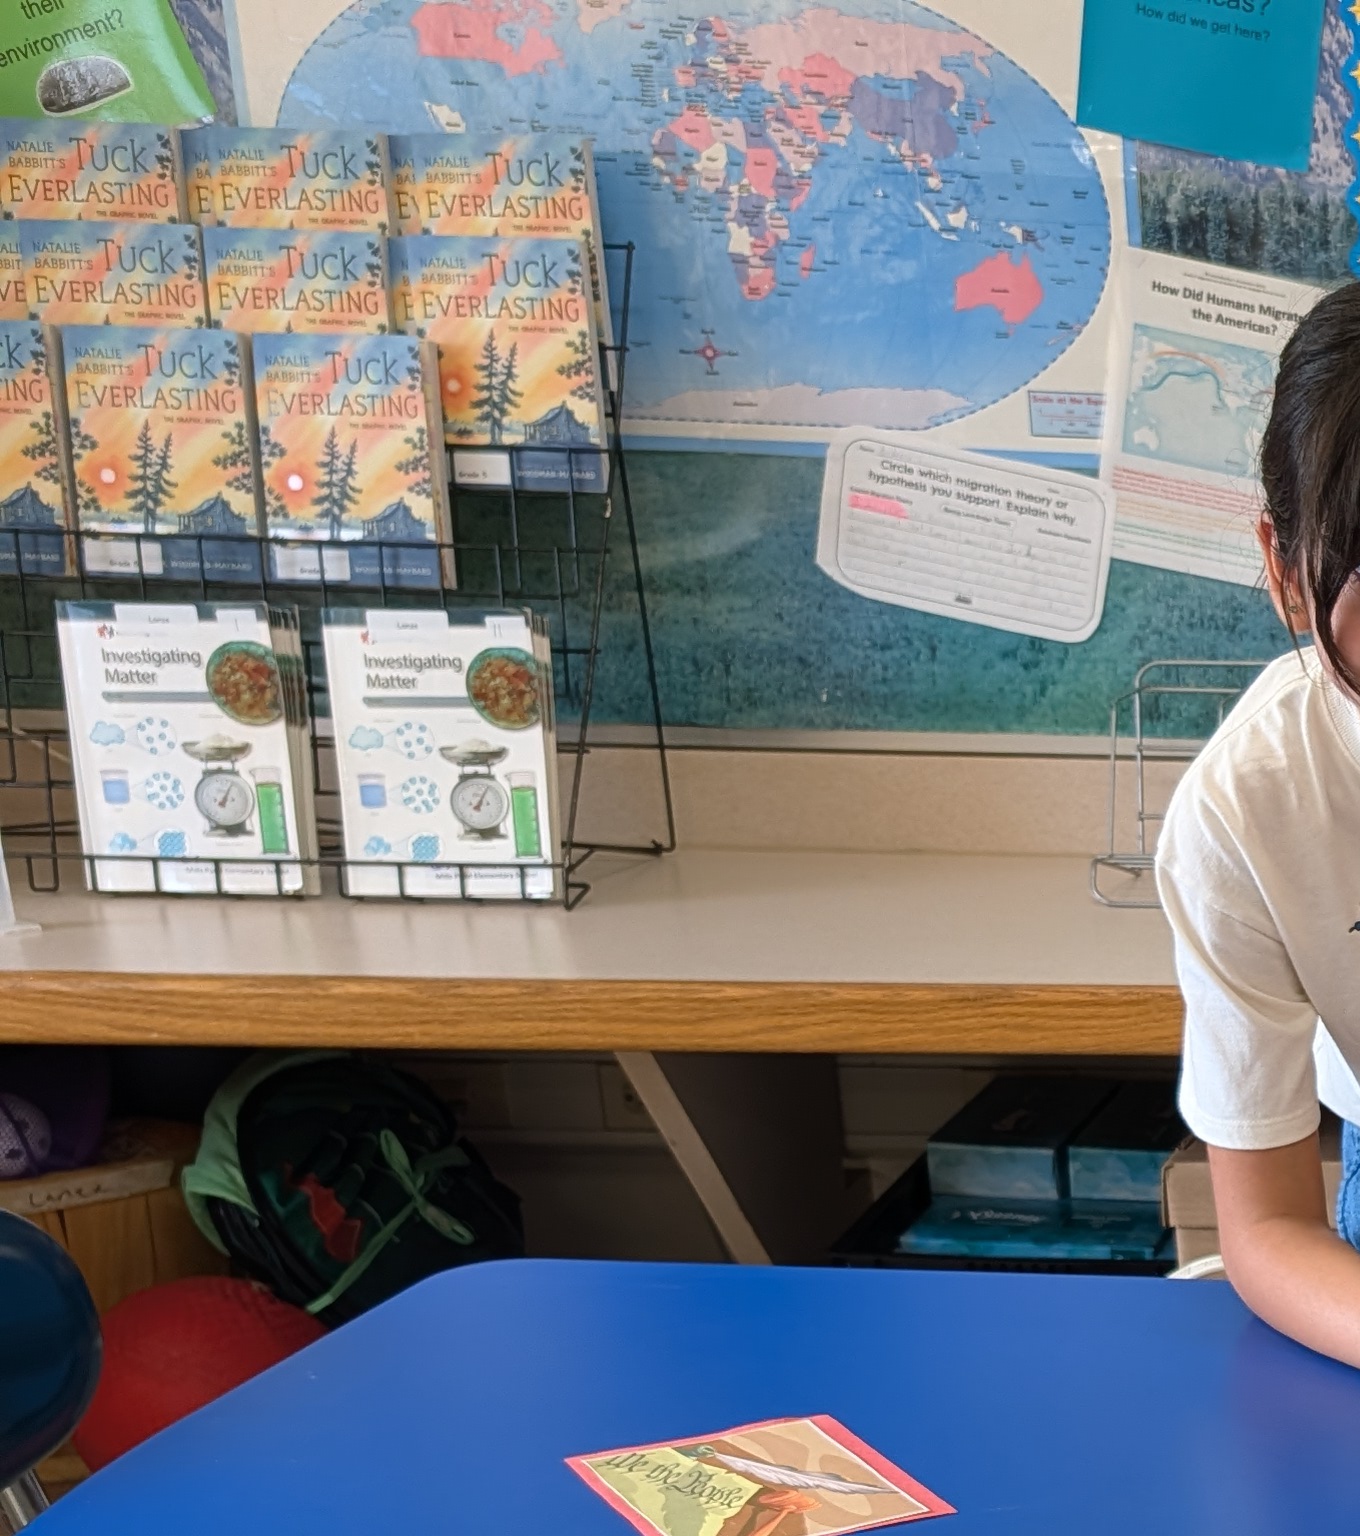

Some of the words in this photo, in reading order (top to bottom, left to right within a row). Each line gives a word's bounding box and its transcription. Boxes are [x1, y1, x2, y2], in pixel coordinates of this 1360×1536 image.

[1136, 3, 1163, 20] How
[1168, 11, 1186, 24] did
[1190, 16, 1207, 30] we
[6, 140, 53, 154] NATALIE
[69, 137, 149, 173] TUCK
[485, 152, 564, 188] TUCK
[9, 174, 169, 208] EVERLASTING
[427, 190, 583, 221] EVERLASTING
[481, 253, 560, 289] TUCK
[424, 292, 580, 322] EVERLASTING
[1152, 280, 1179, 297] How
[1183, 286, 1203, 301] Did
[1207, 292, 1255, 314] Humans
[1192, 308, 1212, 322] the
[1215, 313, 1278, 336] Americas?
[137, 344, 218, 380] TUCK
[76, 381, 237, 414] EVERLASTING
[868, 469, 927, 493] hypothesis
[932, 485, 952, 499] you
[1006, 500, 1049, 520] Explain
[881, 460, 914, 475] Circle
[919, 468, 952, 483] which
[956, 477, 1011, 498] migration
[1016, 489, 1052, 508] theory
[101, 647, 202, 668] Investigating
[363, 653, 463, 673] Investigating
[105, 668, 158, 685] Matter
[366, 673, 418, 690] Matter
[602, 1453, 649, 1473] We
[645, 1463, 681, 1485] the
[667, 1471, 744, 1508] People
